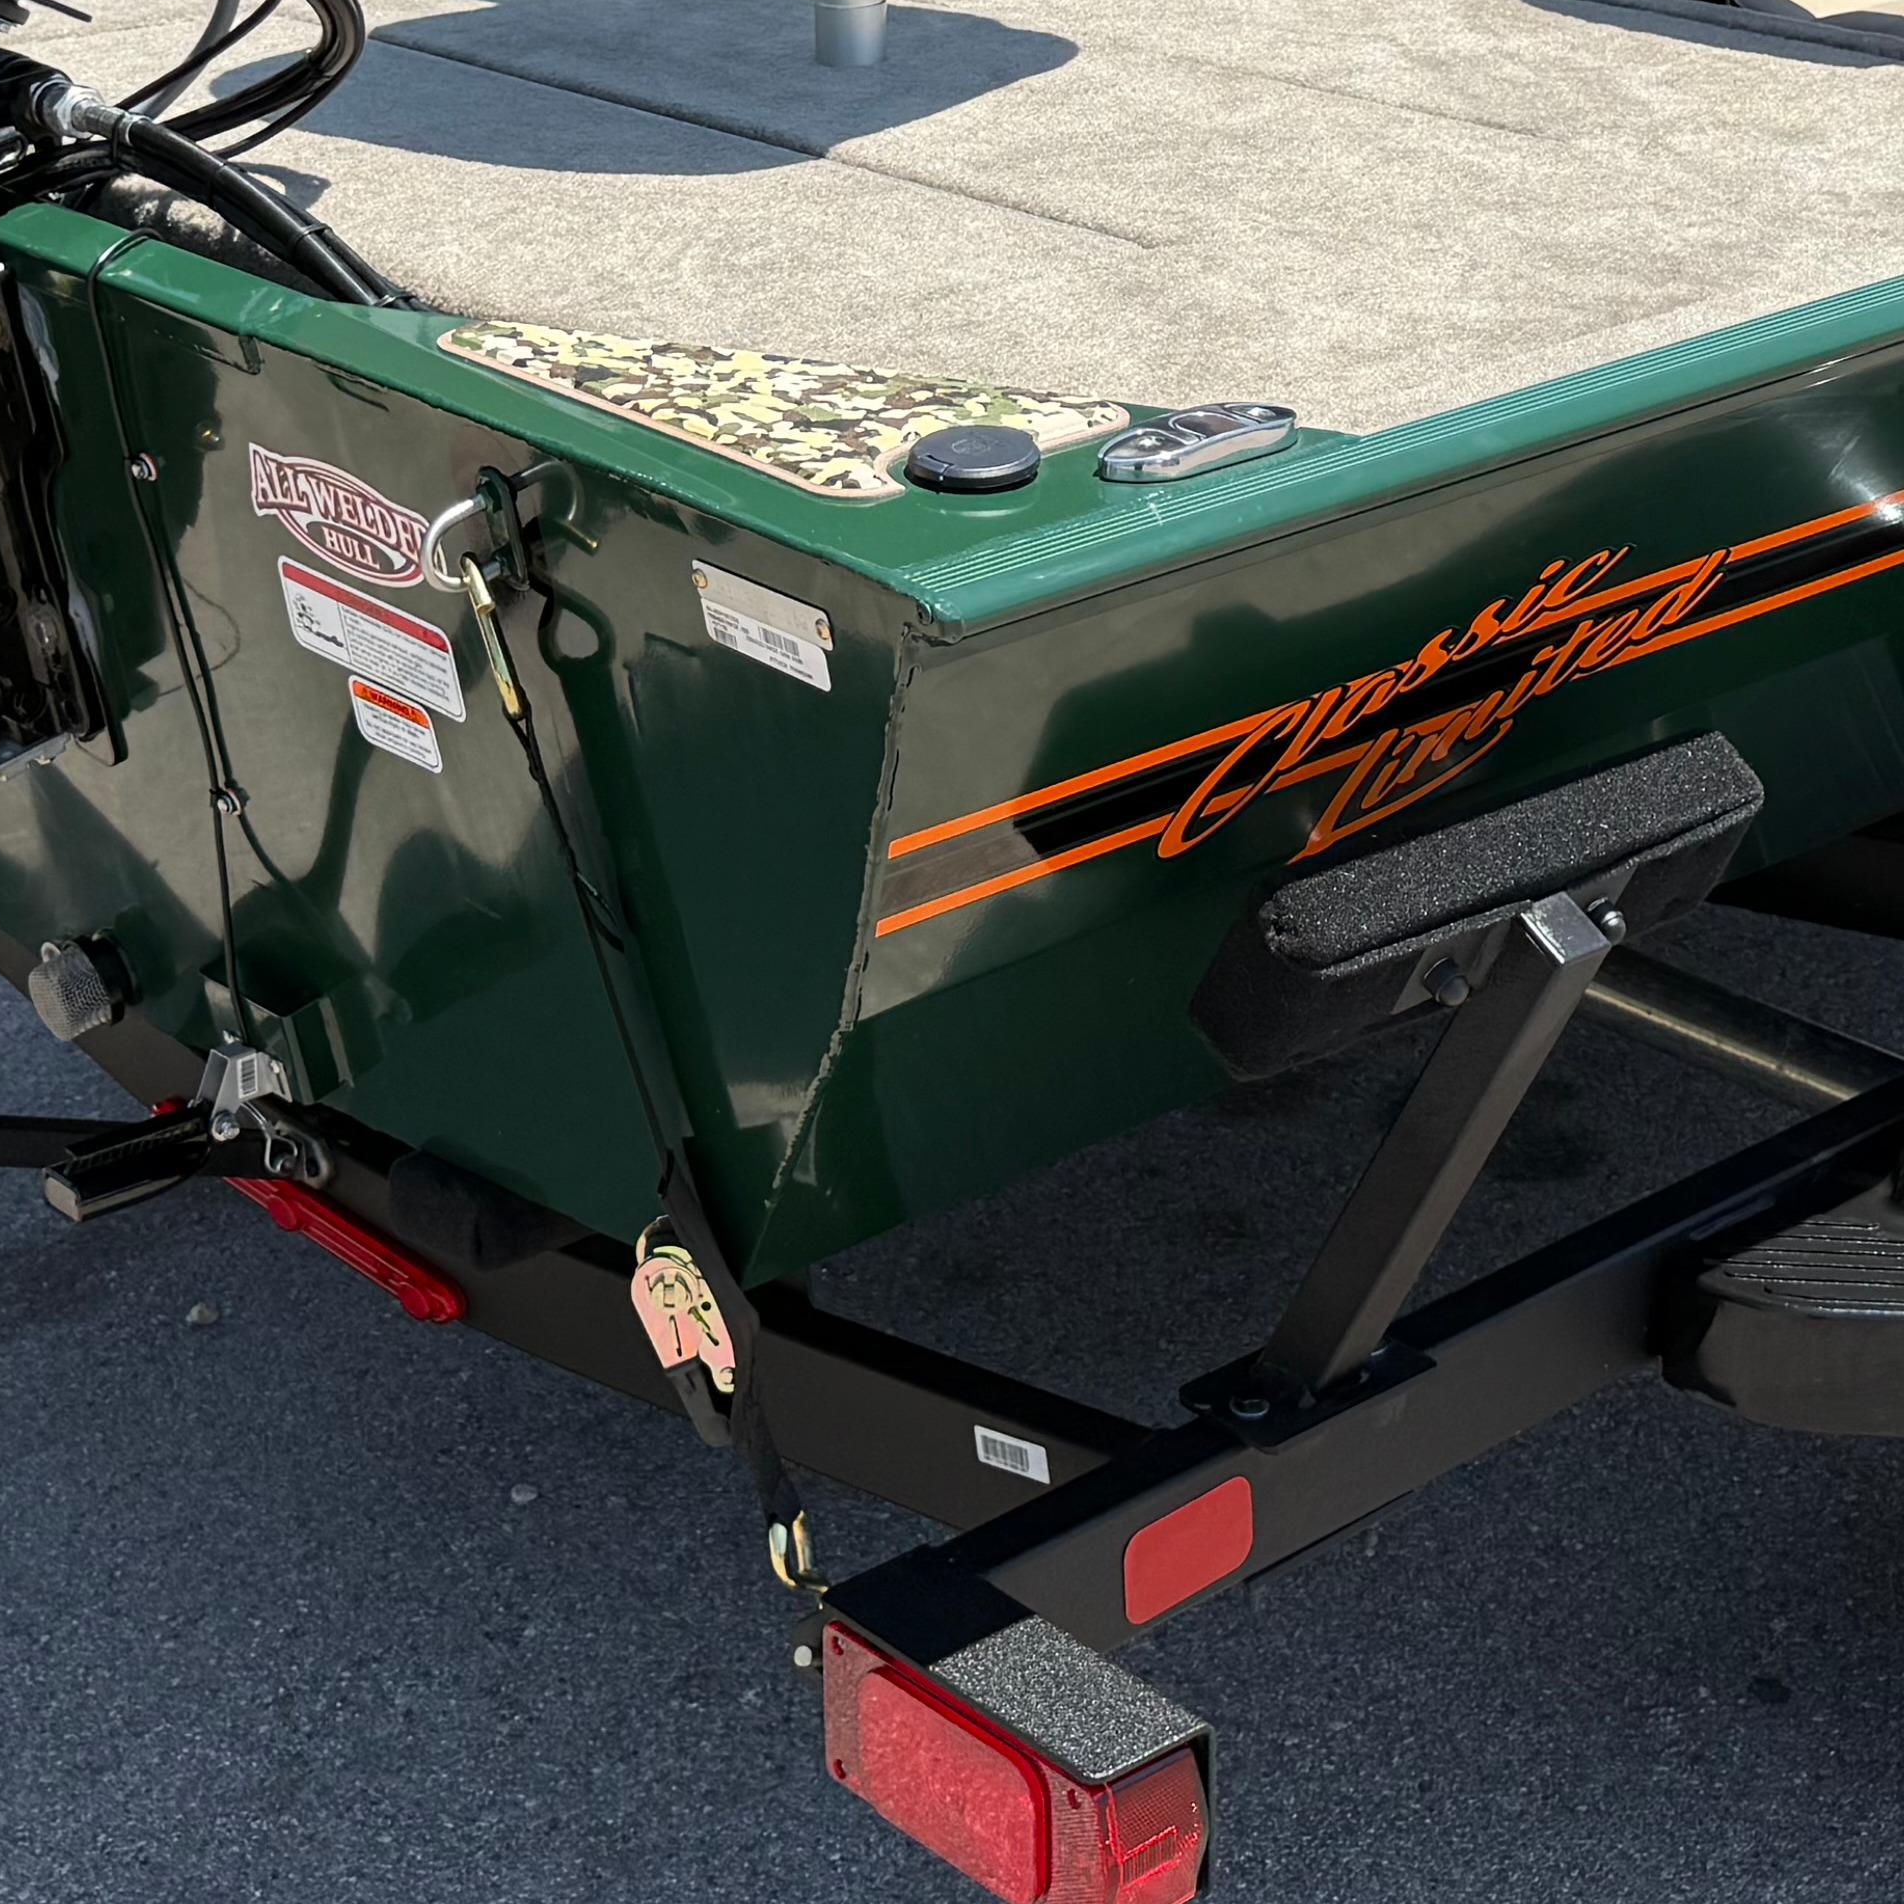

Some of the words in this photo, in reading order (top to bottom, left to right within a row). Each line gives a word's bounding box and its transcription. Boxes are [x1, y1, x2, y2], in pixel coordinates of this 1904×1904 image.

[253, 449, 311, 513] ALL
[322, 524, 381, 570] HULL
[1158, 545, 1632, 859] Classic
[1287, 548, 1731, 866] Limited
